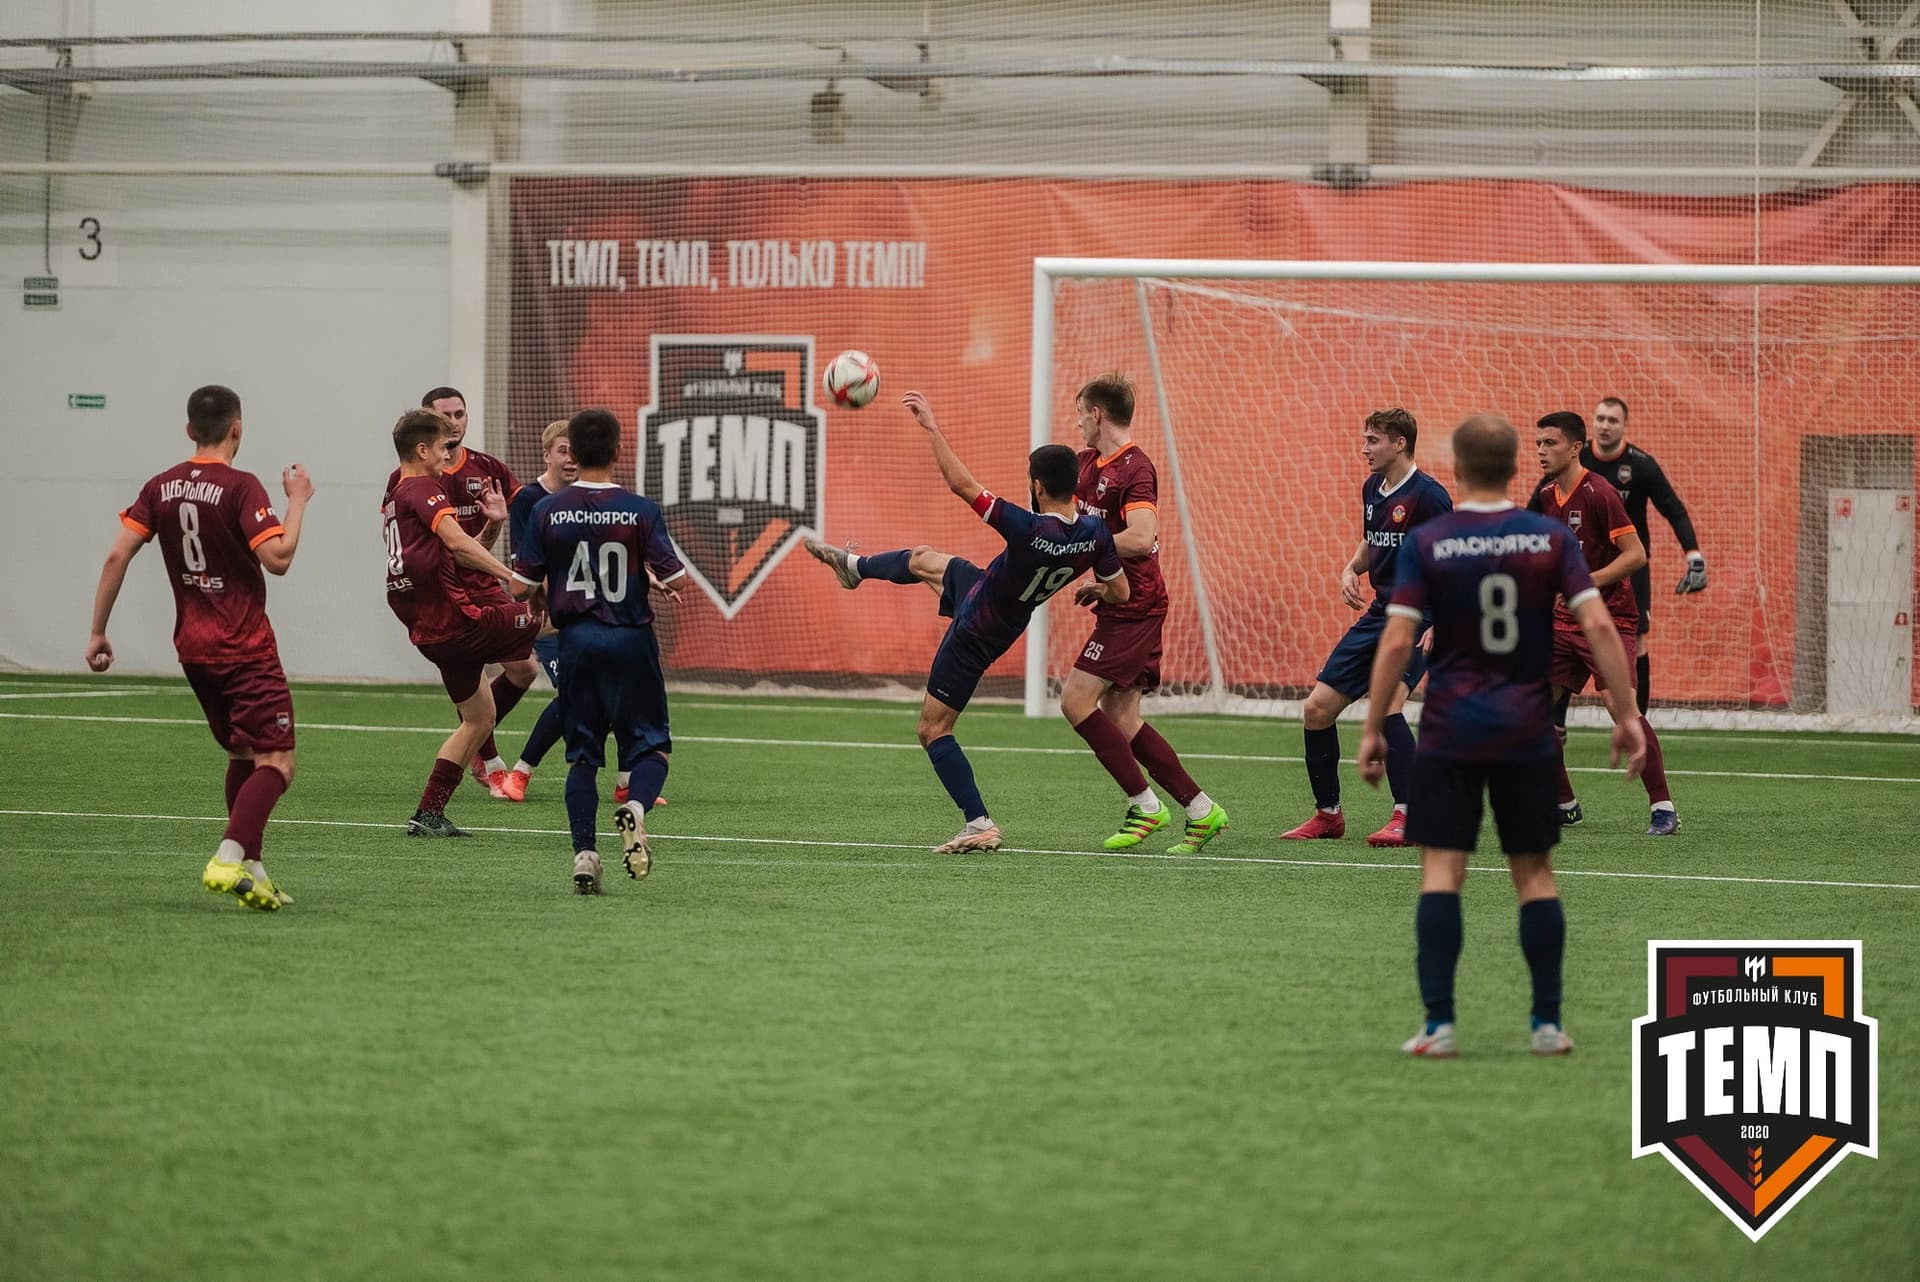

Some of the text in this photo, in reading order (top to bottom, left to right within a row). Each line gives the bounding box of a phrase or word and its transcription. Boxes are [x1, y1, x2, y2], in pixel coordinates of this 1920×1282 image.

[78, 217, 102, 261] 3
[546, 239, 927, 292] ТЕМП, ТЕМП, ТОЛЬКО ТЕМП!
[657, 415, 806, 511] ТЕМП
[179, 502, 207, 571] 8
[550, 510, 639, 527] КРАСНОЯРСК
[1432, 533, 1551, 560] КРАСНОЯРСК
[566, 540, 628, 603] 40
[1018, 566, 1074, 602] 19
[1478, 573, 1520, 654] 8
[1083, 641, 1104, 661] 25
